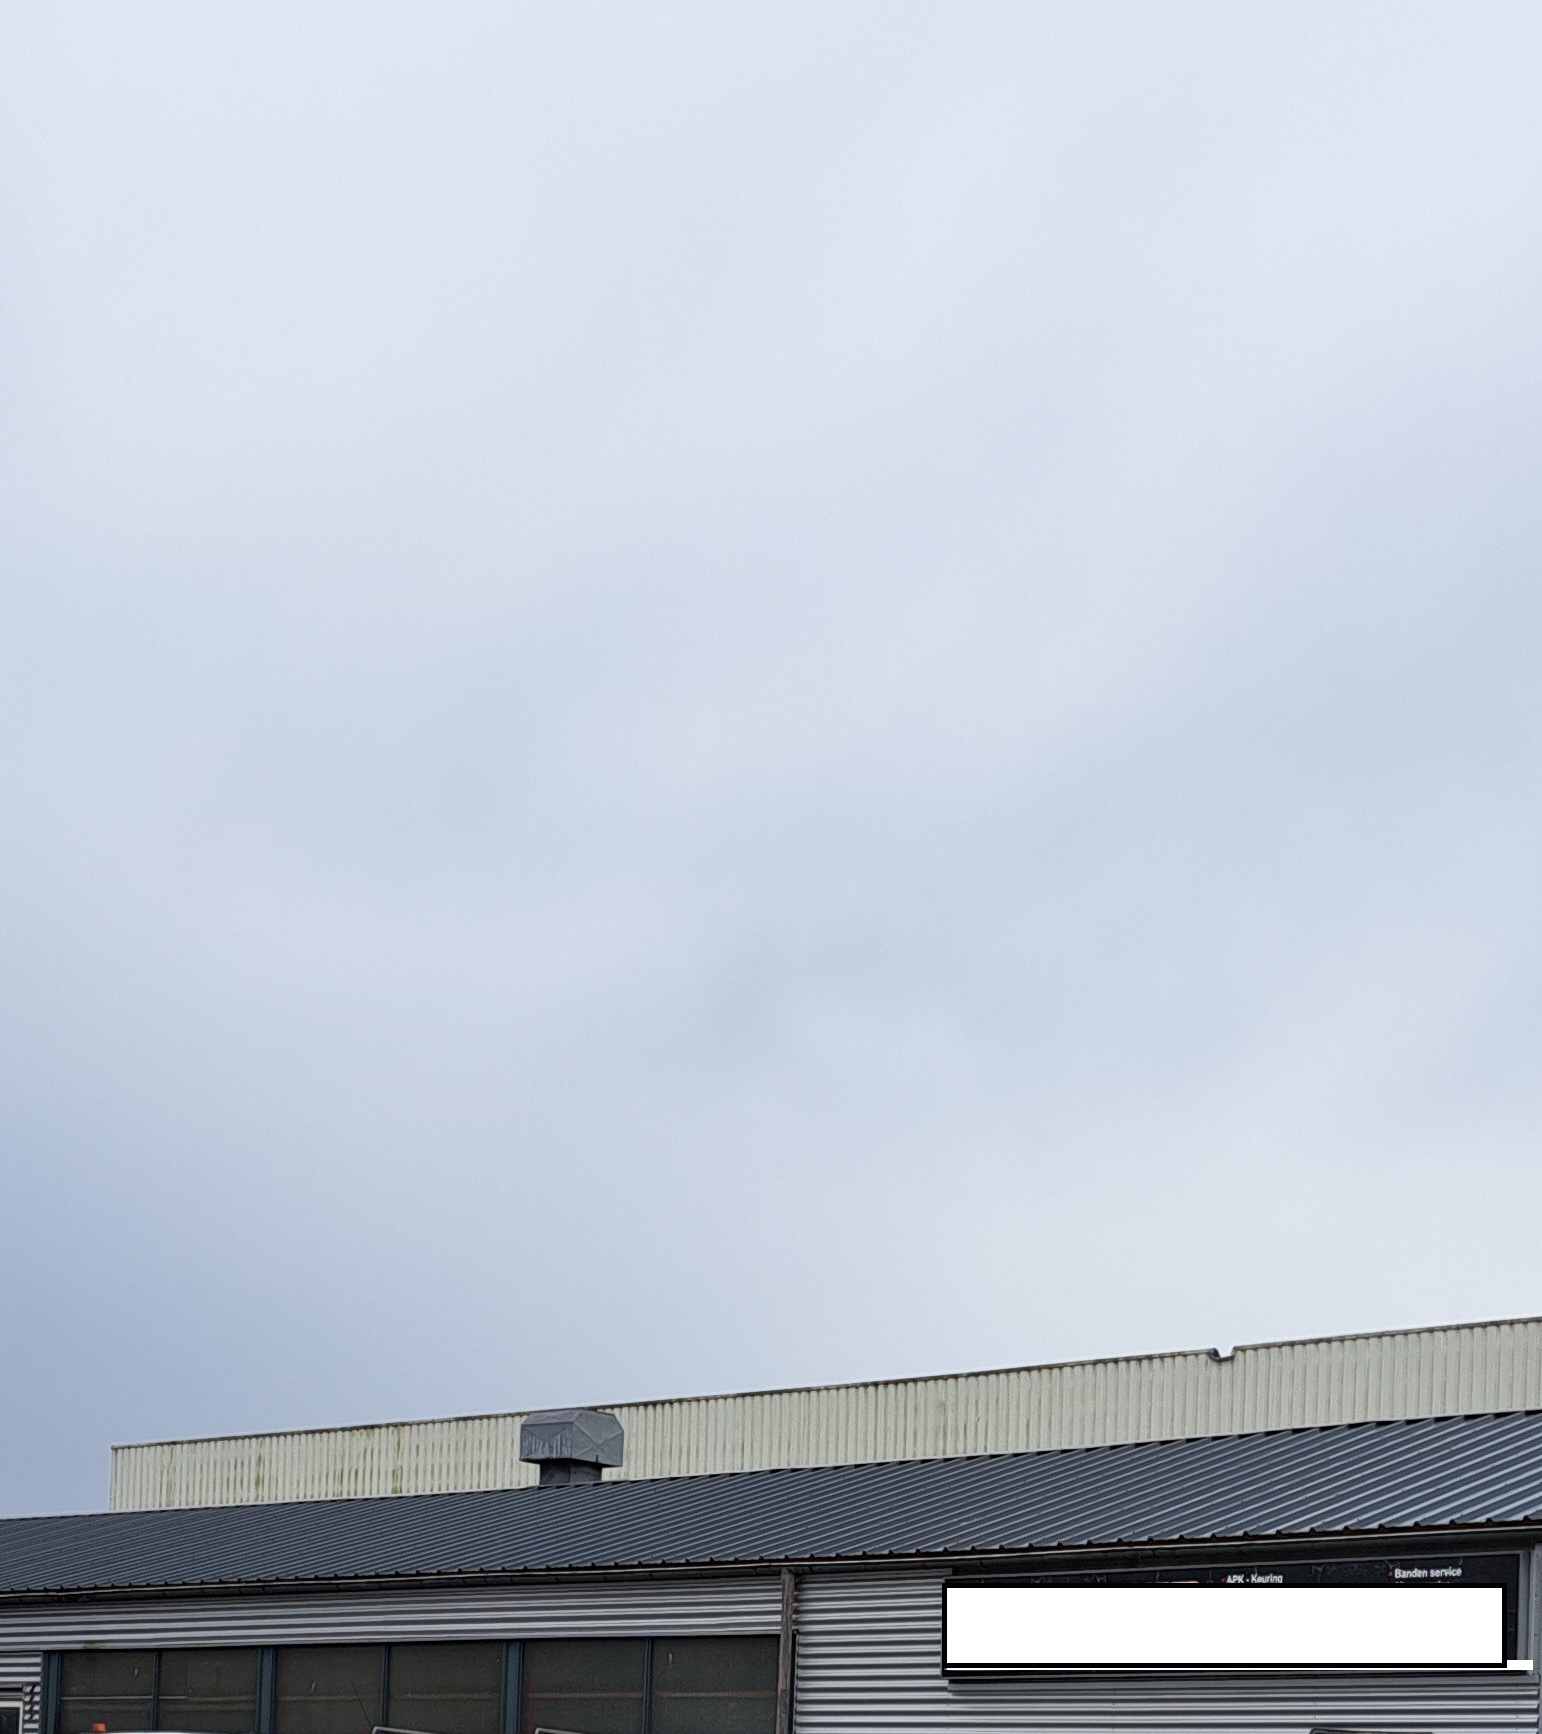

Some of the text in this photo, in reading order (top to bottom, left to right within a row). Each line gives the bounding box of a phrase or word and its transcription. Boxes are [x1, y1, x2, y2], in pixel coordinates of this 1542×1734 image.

[1226, 1573, 1245, 1584] APK
[1394, 1566, 1462, 1579] Banden service
